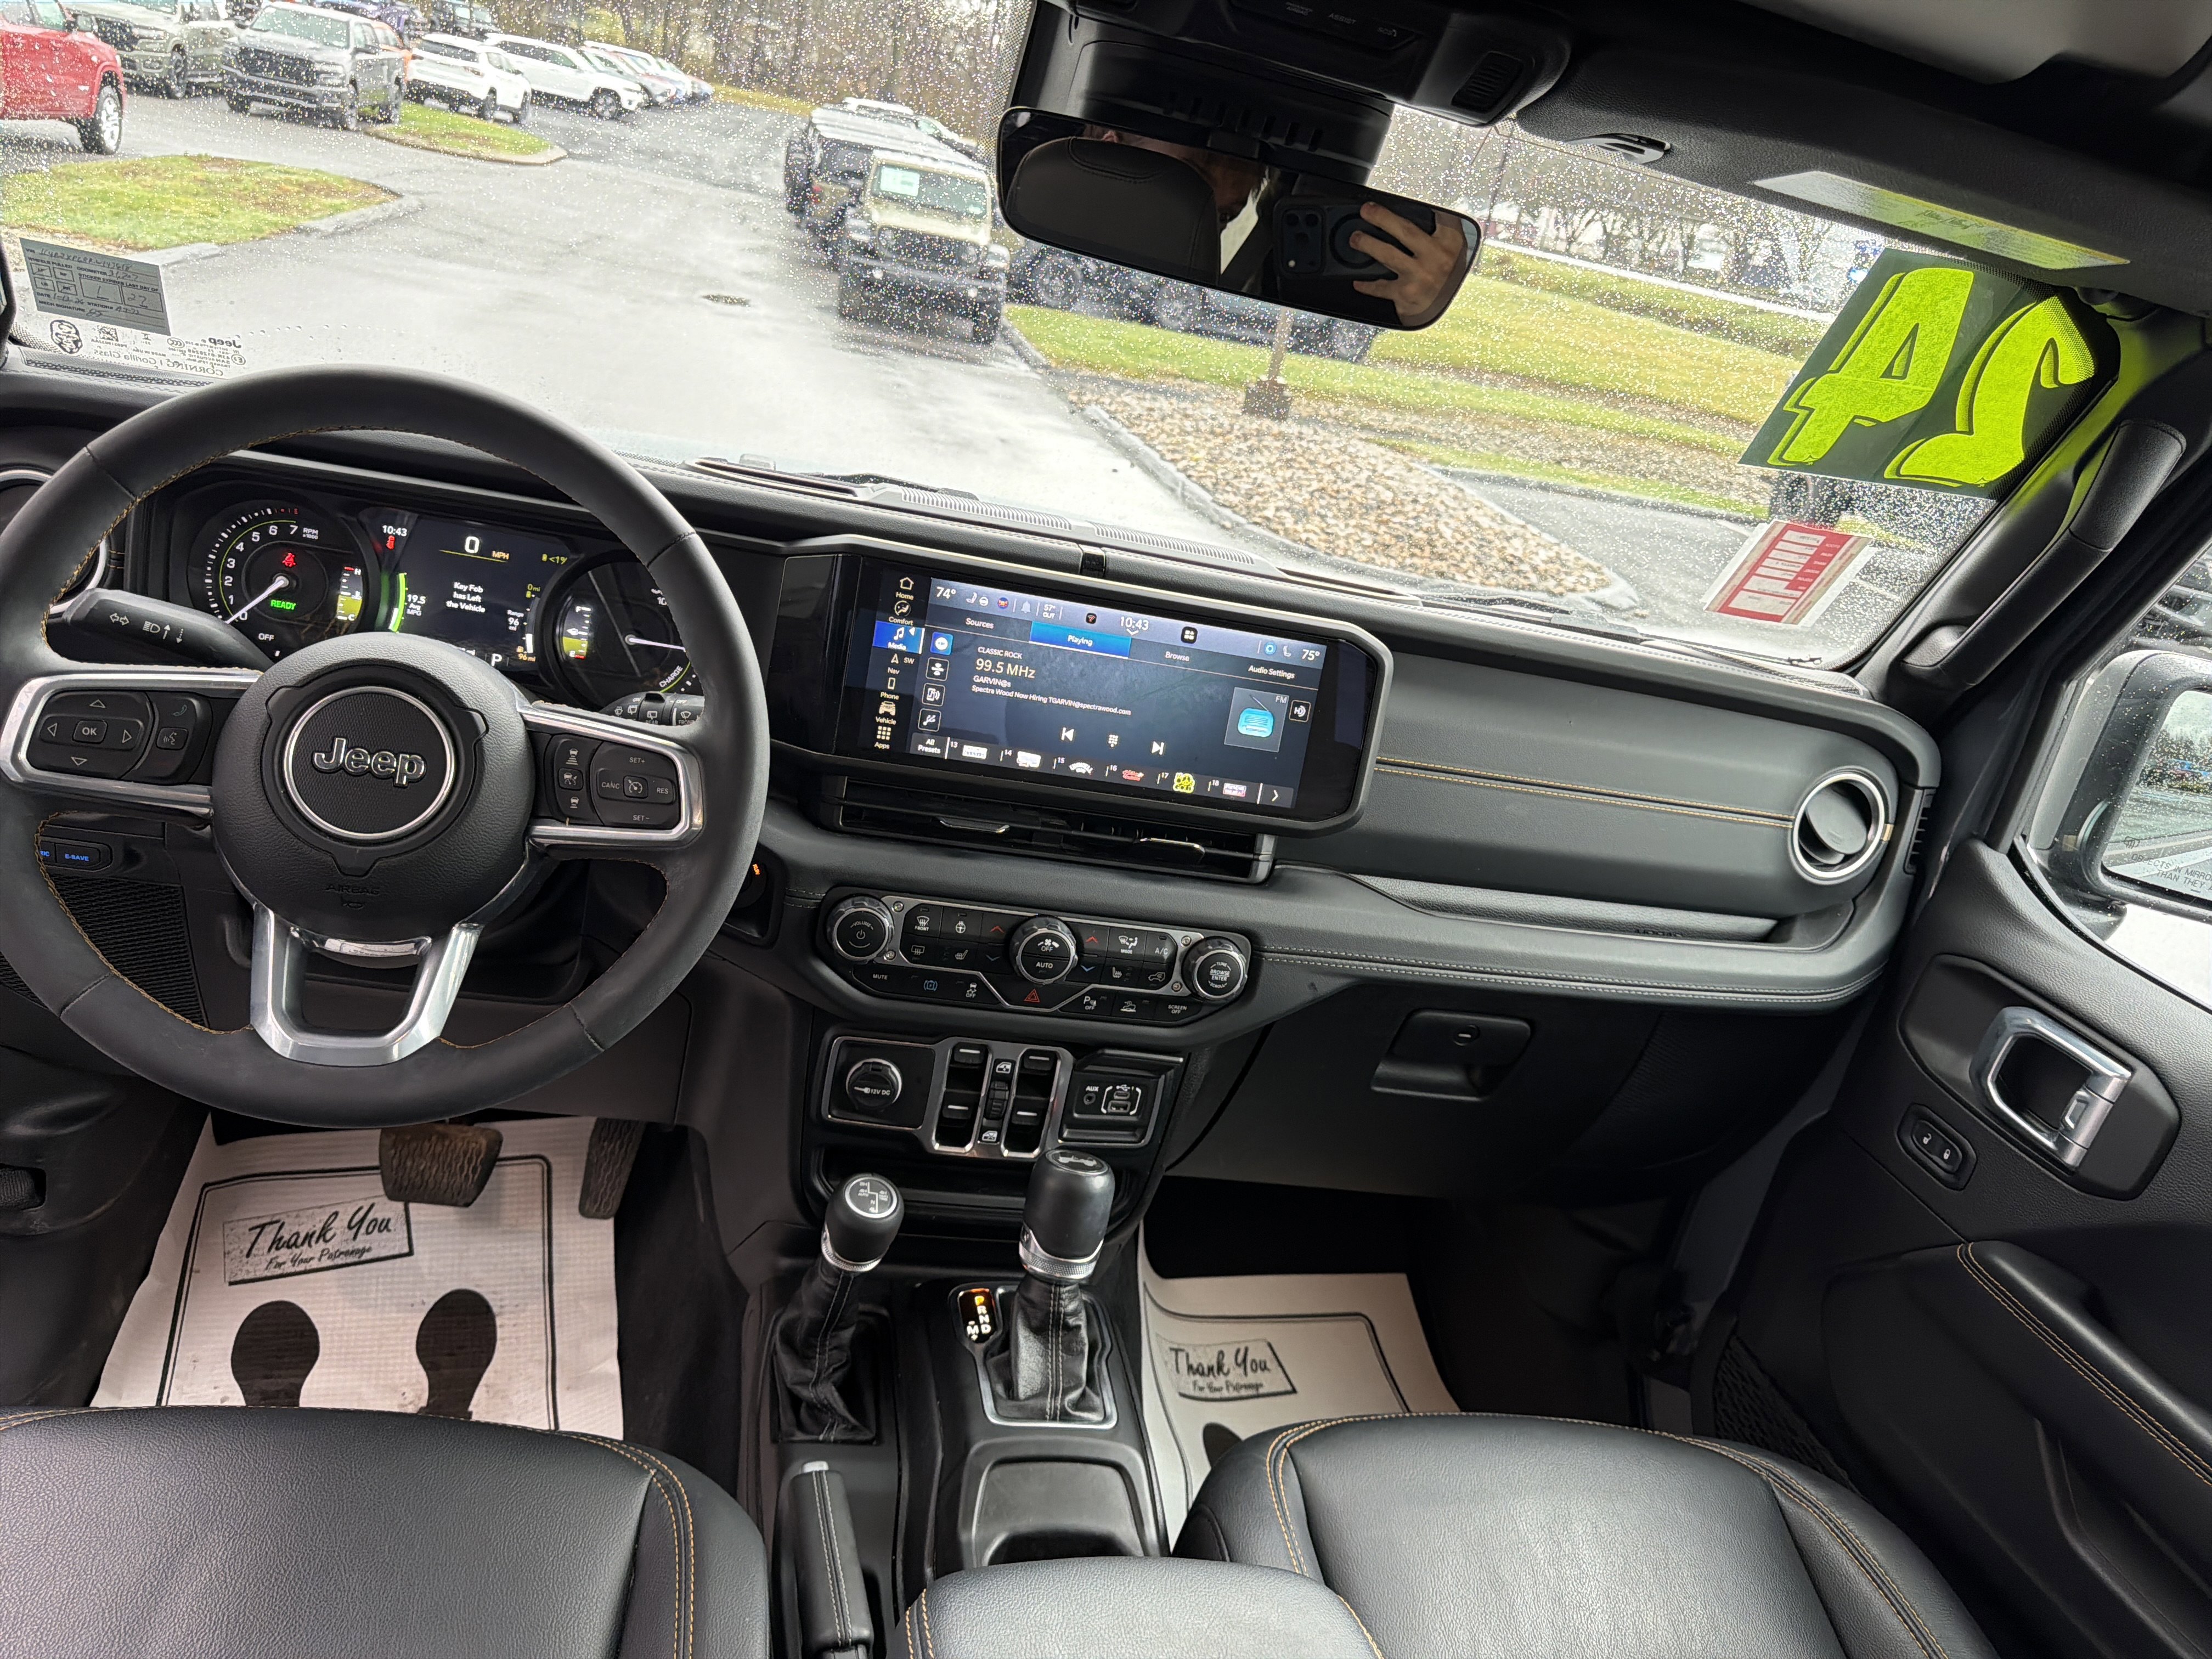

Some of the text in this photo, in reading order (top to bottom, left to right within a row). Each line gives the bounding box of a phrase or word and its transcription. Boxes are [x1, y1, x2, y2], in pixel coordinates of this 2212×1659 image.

[77, 266, 107, 276] ODOMETER
[78, 273, 101, 281] STICKER
[55, 303, 86, 313] SIGNATURE
[269, 526, 278, 535] 6
[290, 525, 298, 535] 7
[382, 525, 407, 537] 10:43
[251, 532, 261, 542] 5
[235, 542, 244, 552] 4
[465, 536, 479, 554] 0
[492, 551, 509, 560] MPH
[227, 558, 235, 568] 3
[224, 577, 233, 586] 2
[454, 582, 483, 594] Key Fob
[936, 586, 956, 599] 74°
[228, 595, 234, 605] 1
[408, 594, 426, 605] 19.5
[453, 591, 482, 603] has Left
[896, 591, 914, 600] Home
[270, 600, 296, 610] READY
[409, 603, 421, 611] Avg
[446, 600, 486, 613] the Vehicle
[240, 612, 247, 621] 0
[407, 608, 422, 617] MPG
[507, 610, 524, 618] Range
[508, 617, 520, 626] 96
[889, 617, 913, 625] Comfort
[966, 618, 994, 629] Sources
[1120, 616, 1150, 631] 10:43
[1068, 635, 1093, 647] Playing
[888, 642, 907, 651] Media
[978, 646, 1023, 659] CLASSIC ROCK
[1165, 651, 1190, 662] Browse
[1302, 650, 1321, 661] 75°
[491, 653, 502, 667] P
[976, 659, 1036, 679] 99.5 MHz
[1249, 665, 1295, 680] Audio Settings
[659, 665, 684, 689] CHARGE
[972, 685, 996, 696] Spectra
[997, 689, 1014, 698] Wood
[1014, 691, 1029, 699] Now
[1029, 693, 1048, 704] Hiring
[1275, 696, 1287, 704] FM
[876, 716, 896, 725] Vehicle
[82, 727, 97, 736] OK
[874, 742, 890, 751] Apps
[918, 745, 941, 754] Presets
[313, 737, 426, 787] Jeep
[65, 853, 89, 861] E-SAVE
[2174, 865, 2182, 873] IN
[2185, 868, 2212, 881] MIRRO
[2157, 869, 2180, 882] THAN
[2183, 877, 2205, 888] THEY
[326, 884, 380, 896] AIRBAG
[1154, 946, 1169, 956] A/C
[246, 1201, 393, 1259] Thank You
[264, 1244, 373, 1272] For Your Patronage
[978, 1305, 987, 1314] R
[979, 1314, 990, 1324] N
[967, 1324, 991, 1335] M D
[1169, 1346, 1271, 1378] Thank You
[1192, 1381, 1205, 1392] For
